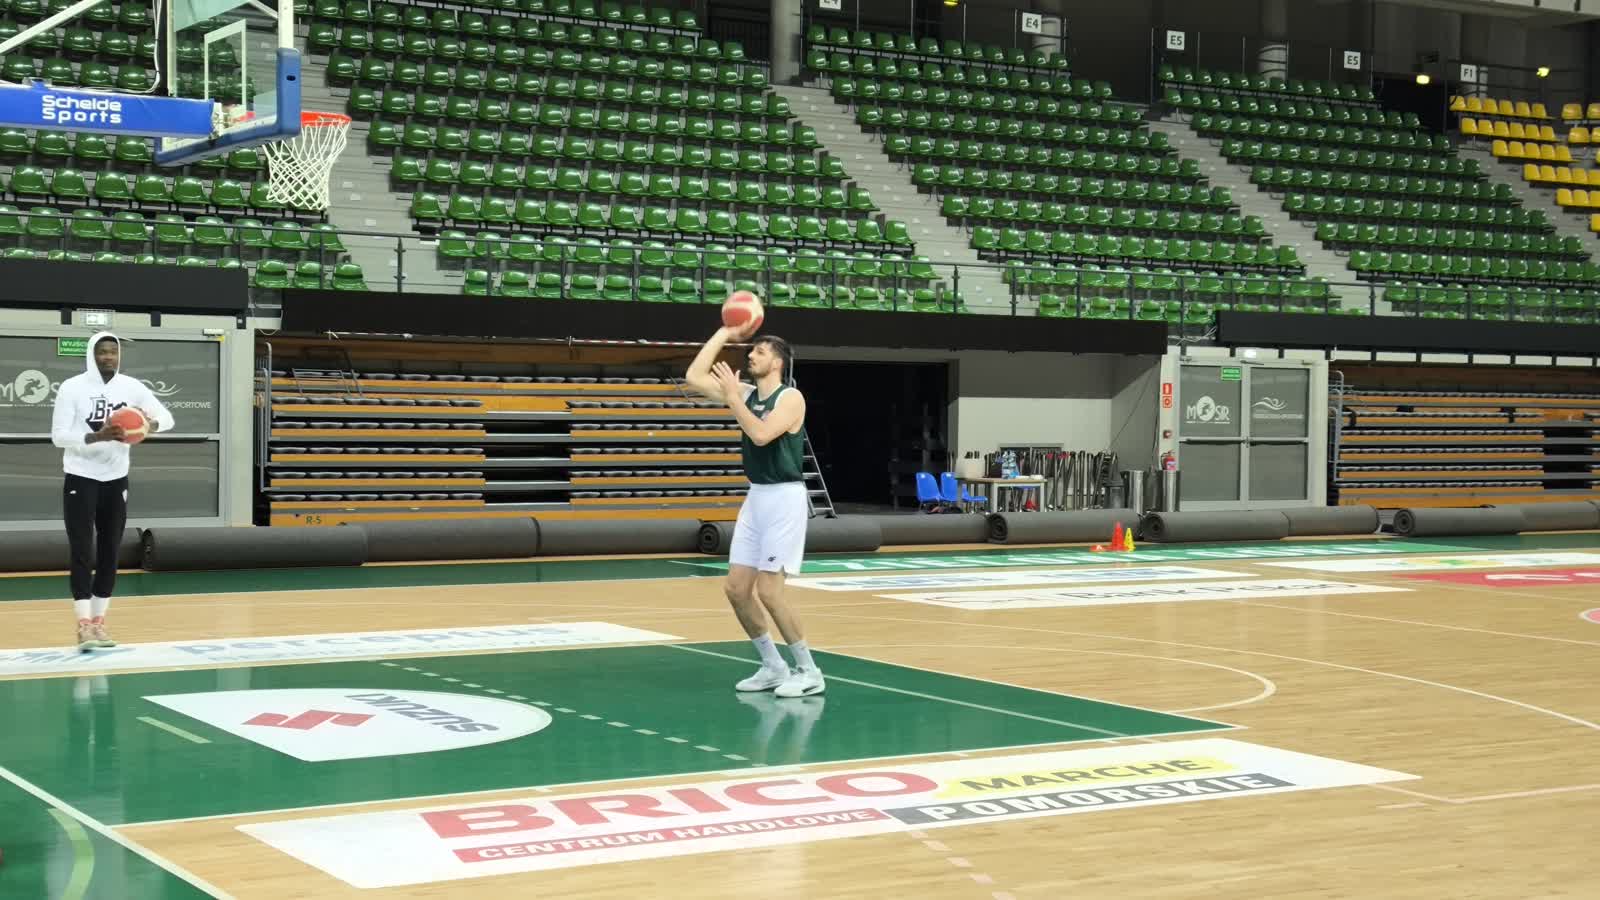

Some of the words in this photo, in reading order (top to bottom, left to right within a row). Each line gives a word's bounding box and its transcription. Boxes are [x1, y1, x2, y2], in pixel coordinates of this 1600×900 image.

[1026, 18, 1039, 28] E4
[1170, 35, 1182, 45] E5
[1346, 55, 1358, 66] E5
[42, 107, 122, 123] Sports
[344, 693, 499, 733] SUZUKI
[960, 760, 1212, 790] MARCHE
[420, 771, 938, 838] BRICO
[918, 775, 1276, 821] POMORSKIE
[478, 832, 663, 858] CENTRUM
[672, 810, 869, 839] HANDLOWE
